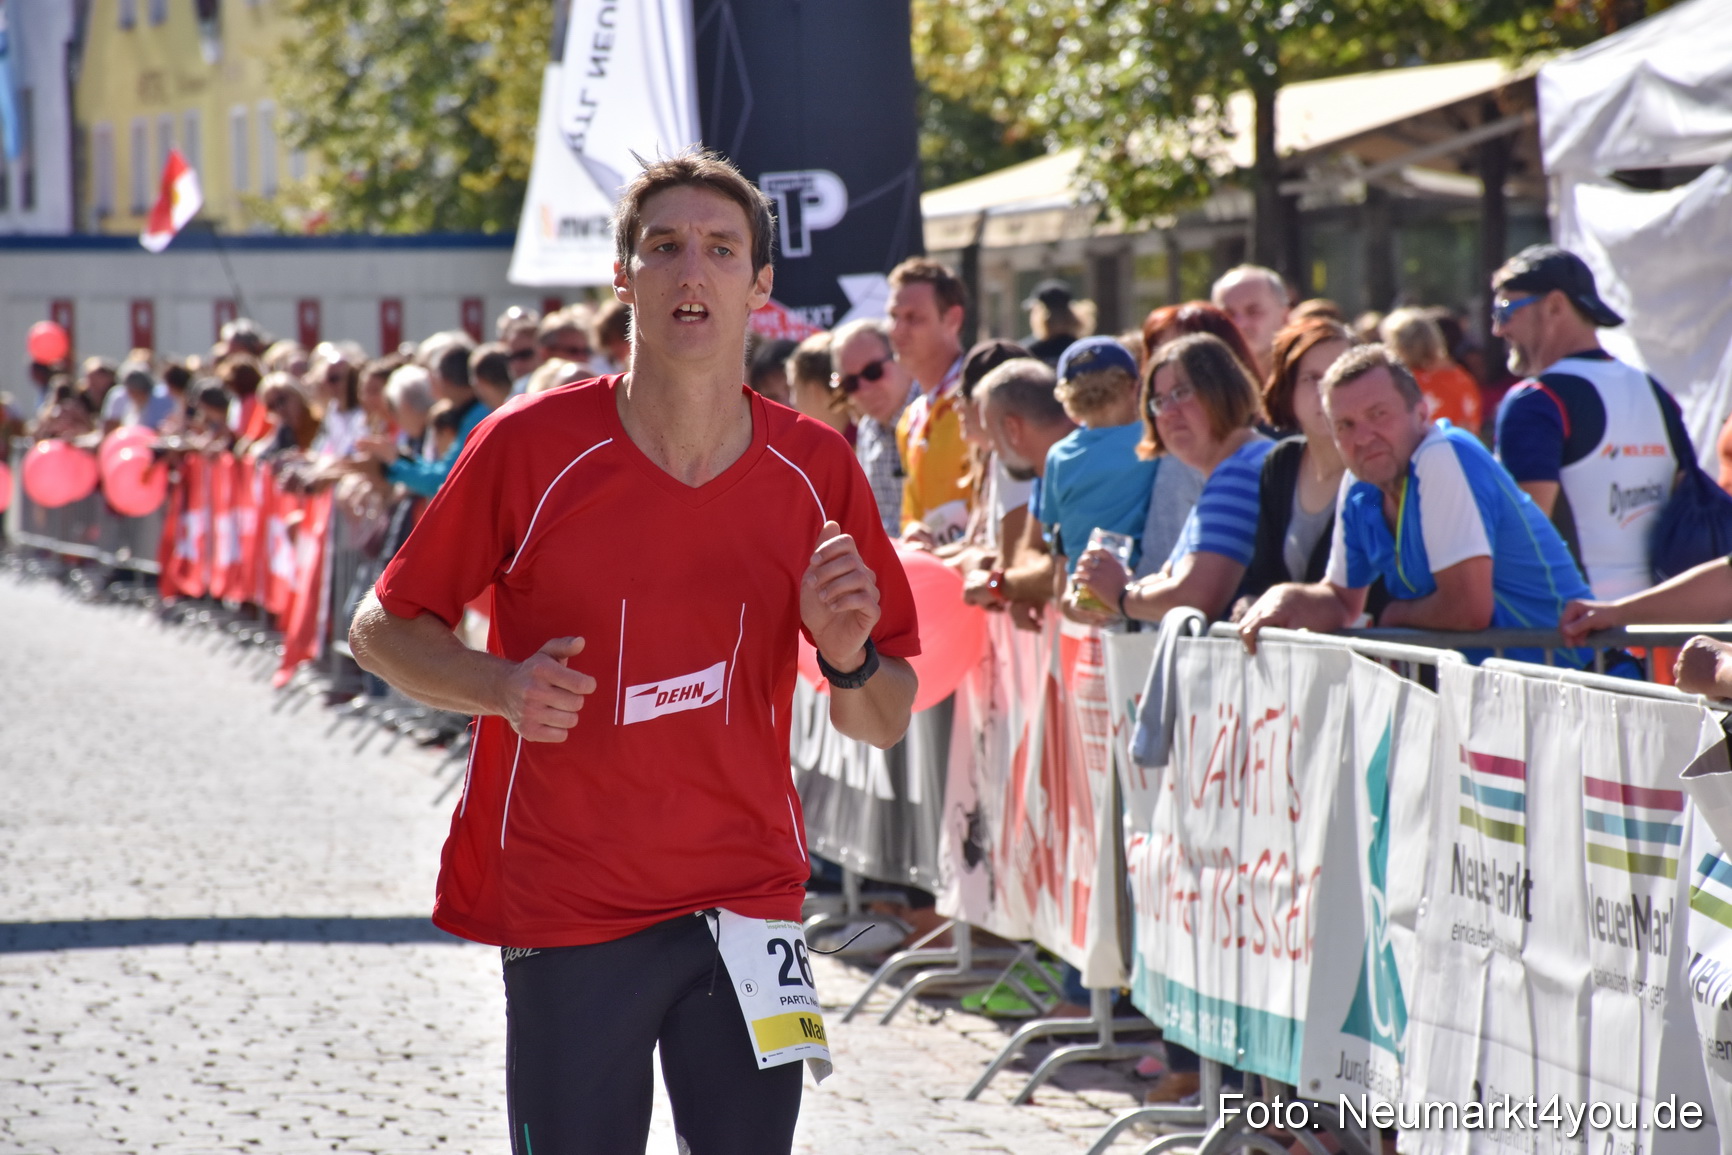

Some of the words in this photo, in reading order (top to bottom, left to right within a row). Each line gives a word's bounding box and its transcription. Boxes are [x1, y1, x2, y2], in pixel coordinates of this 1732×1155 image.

[655, 681, 705, 708] DEHN
[745, 983, 753, 993] B
[780, 995, 810, 1006] PARTL
